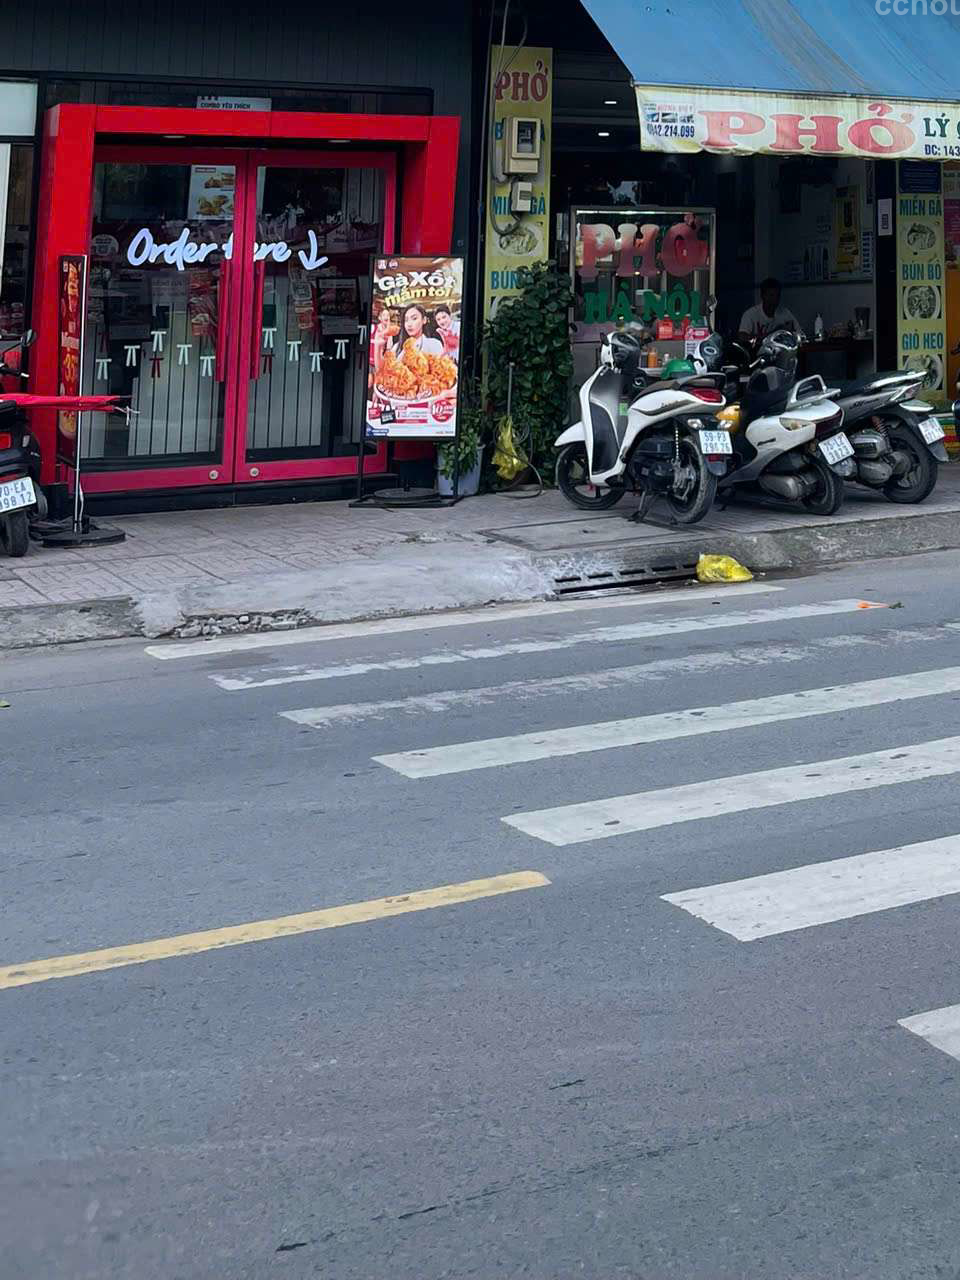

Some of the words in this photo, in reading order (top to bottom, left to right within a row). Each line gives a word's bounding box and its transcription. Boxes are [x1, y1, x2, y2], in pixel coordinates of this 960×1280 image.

[495, 60, 548, 102] PHỞ
[699, 102, 917, 155] PHỞ
[923, 113, 950, 137] LÝ
[928, 195, 943, 216] GÀ
[127, 227, 218, 271] Order
[902, 260, 925, 281] BÚN
[923, 331, 944, 350] HEO
